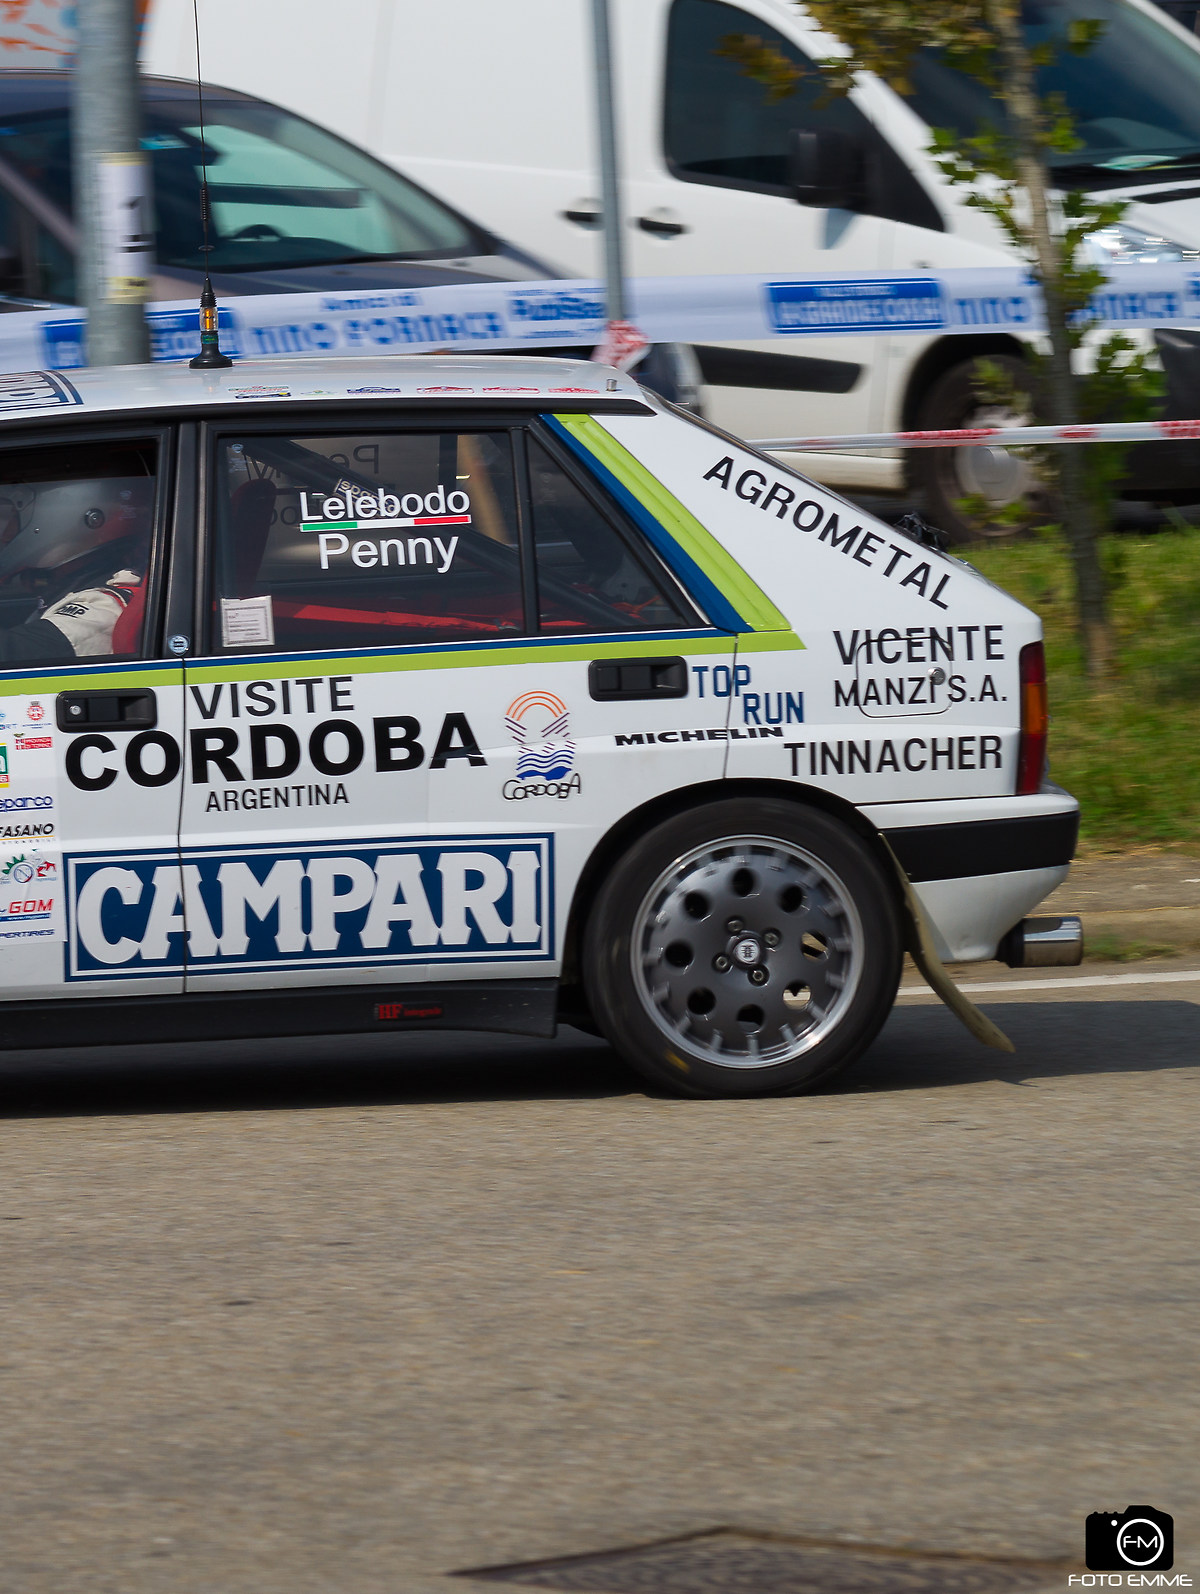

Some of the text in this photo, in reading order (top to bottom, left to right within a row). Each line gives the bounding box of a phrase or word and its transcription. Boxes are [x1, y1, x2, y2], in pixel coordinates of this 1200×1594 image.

[300, 485, 471, 521] Lelebodo
[703, 456, 952, 611] AGROMETAL
[318, 533, 459, 574] Penny
[833, 625, 1005, 665] VICENTE
[190, 676, 354, 720] VISITE
[692, 664, 752, 699] TOP
[834, 674, 1007, 707] MANZI S.A.
[743, 691, 805, 725] RUN
[65, 712, 488, 792] CORDOBA
[614, 727, 783, 746] MICHELIN
[783, 735, 1003, 777] TINNACHER
[205, 782, 350, 813] ARGENTINA
[502, 771, 582, 801] CORDOBA
[8, 899, 54, 914] GOM
[78, 851, 542, 964] CAMPARI
